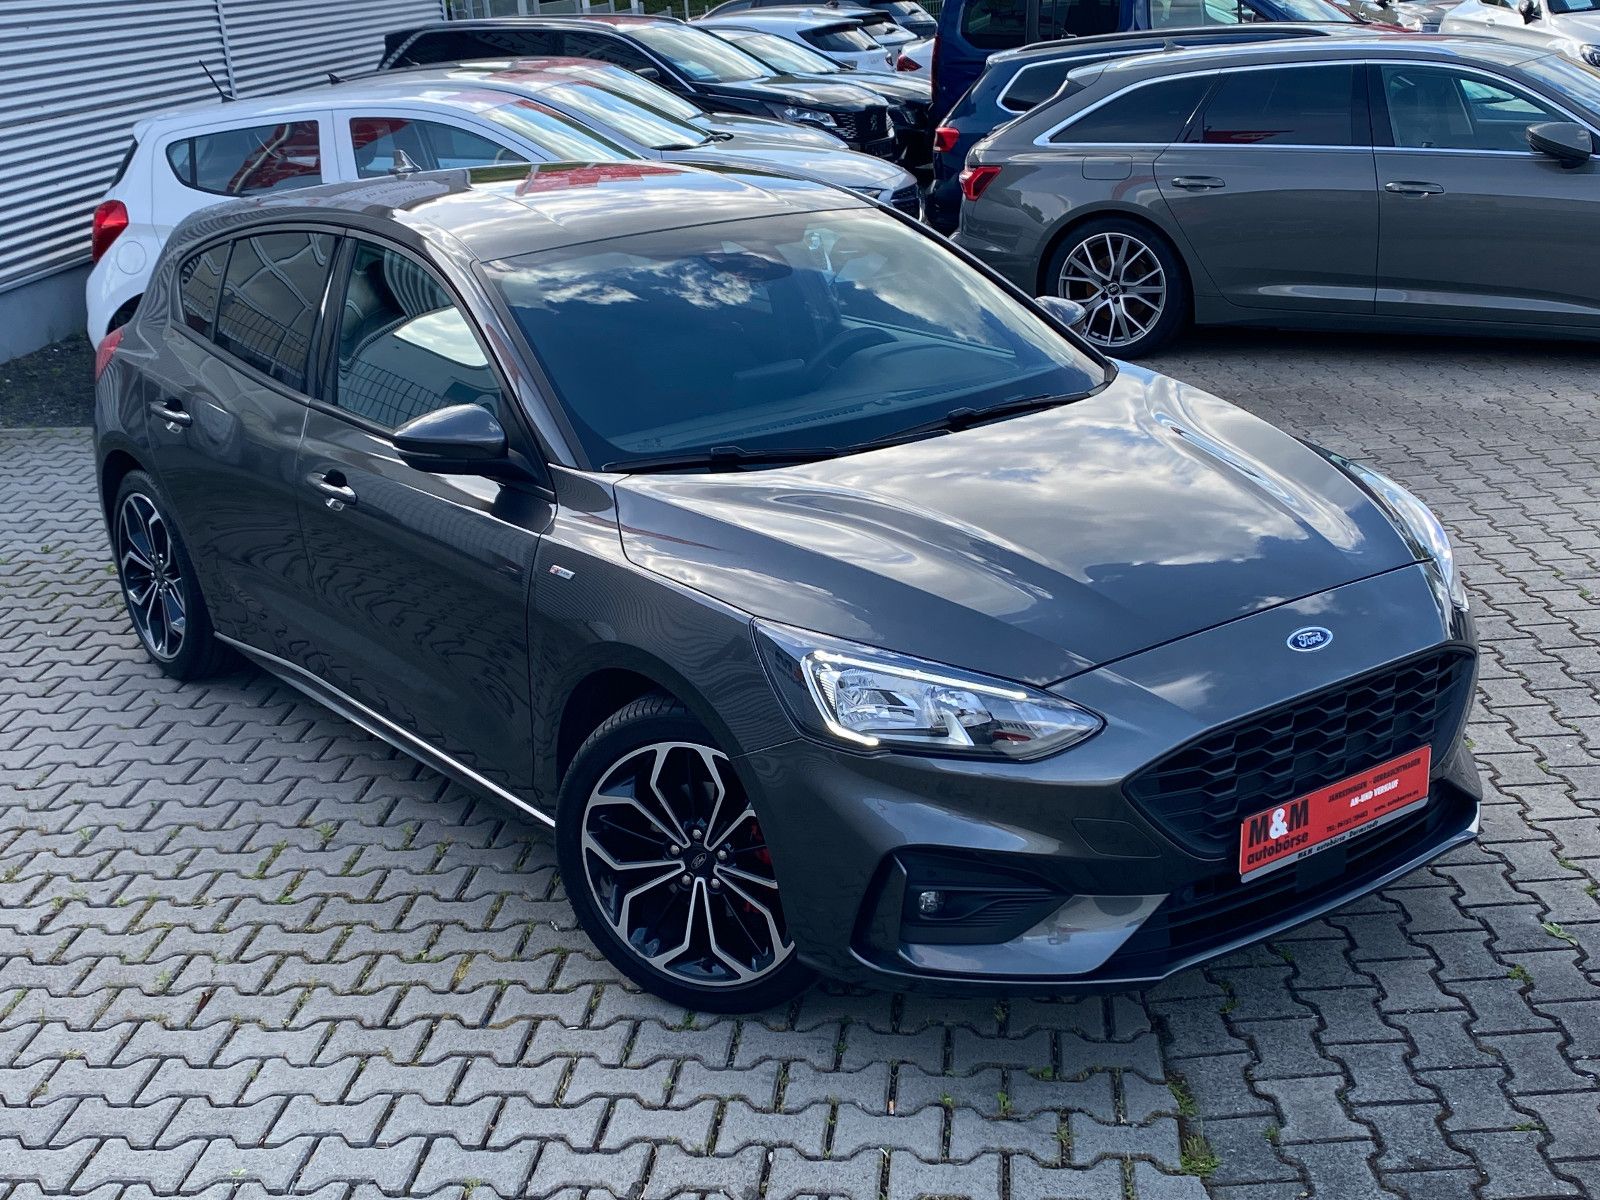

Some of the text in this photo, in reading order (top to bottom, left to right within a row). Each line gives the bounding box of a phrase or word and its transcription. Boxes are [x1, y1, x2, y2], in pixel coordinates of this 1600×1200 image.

[1298, 632, 1324, 647] Ford
[1374, 778, 1399, 797] VERKAUF
[1248, 798, 1309, 849] M&M
[1247, 830, 1309, 865] autobörse
